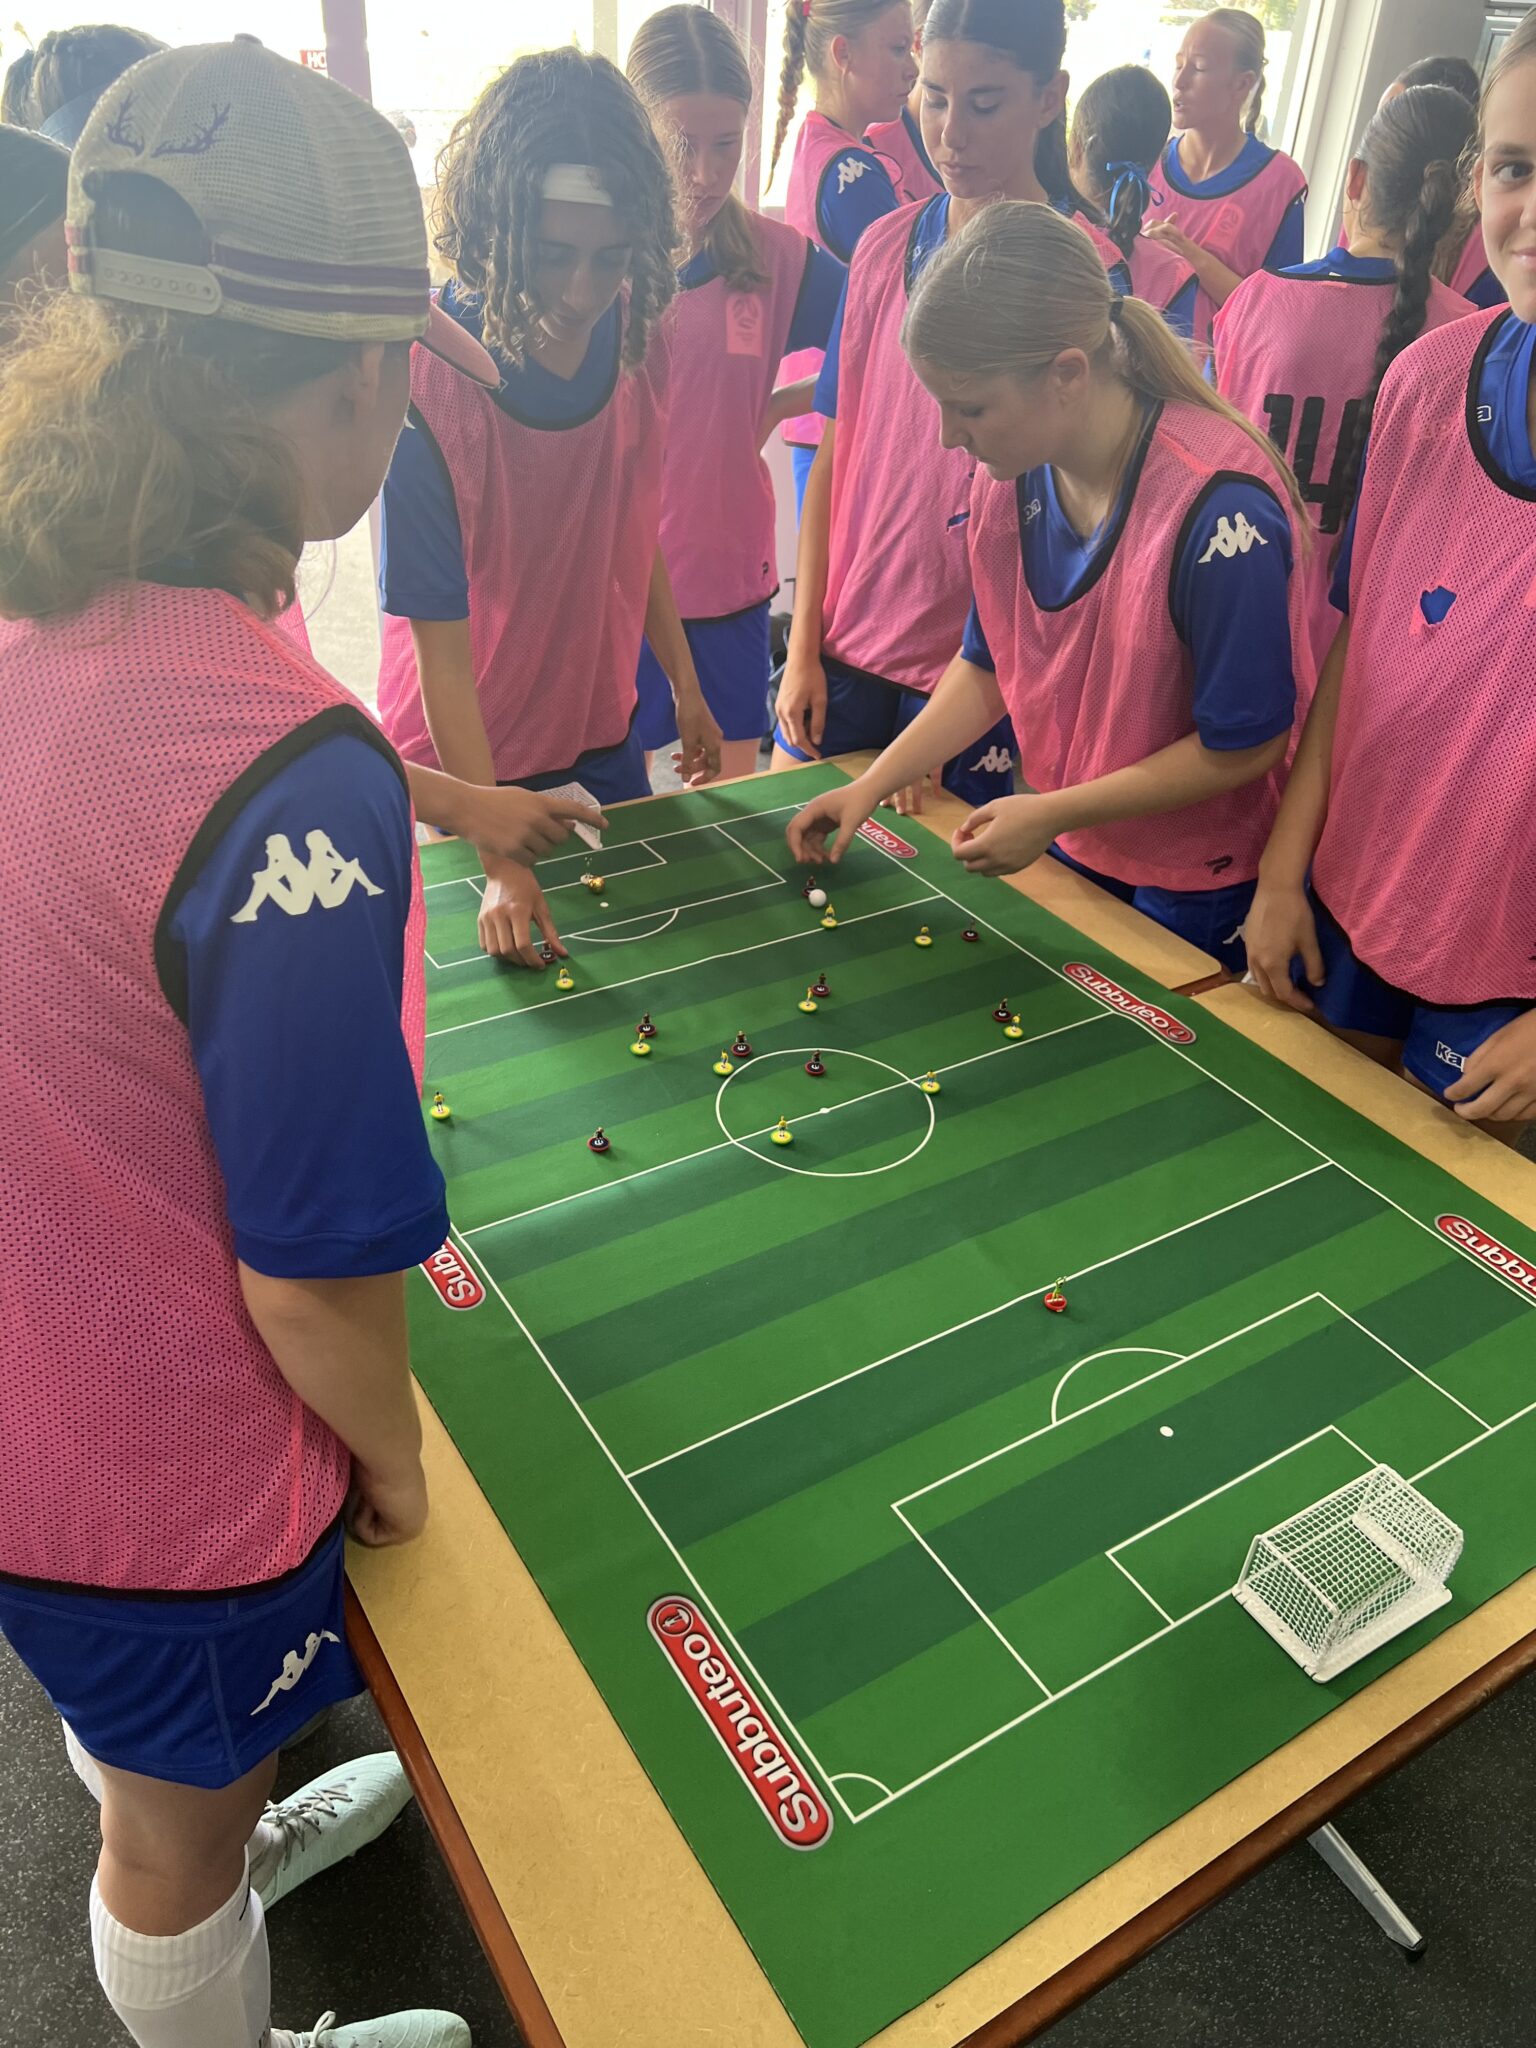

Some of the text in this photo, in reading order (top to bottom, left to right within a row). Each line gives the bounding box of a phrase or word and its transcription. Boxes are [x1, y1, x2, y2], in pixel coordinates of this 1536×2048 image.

[1070, 966, 1169, 1028] Subbuteo
[1435, 1040, 1465, 1072] Ka
[431, 1244, 476, 1302] Sub
[683, 1633, 819, 1833] Subbuteo
